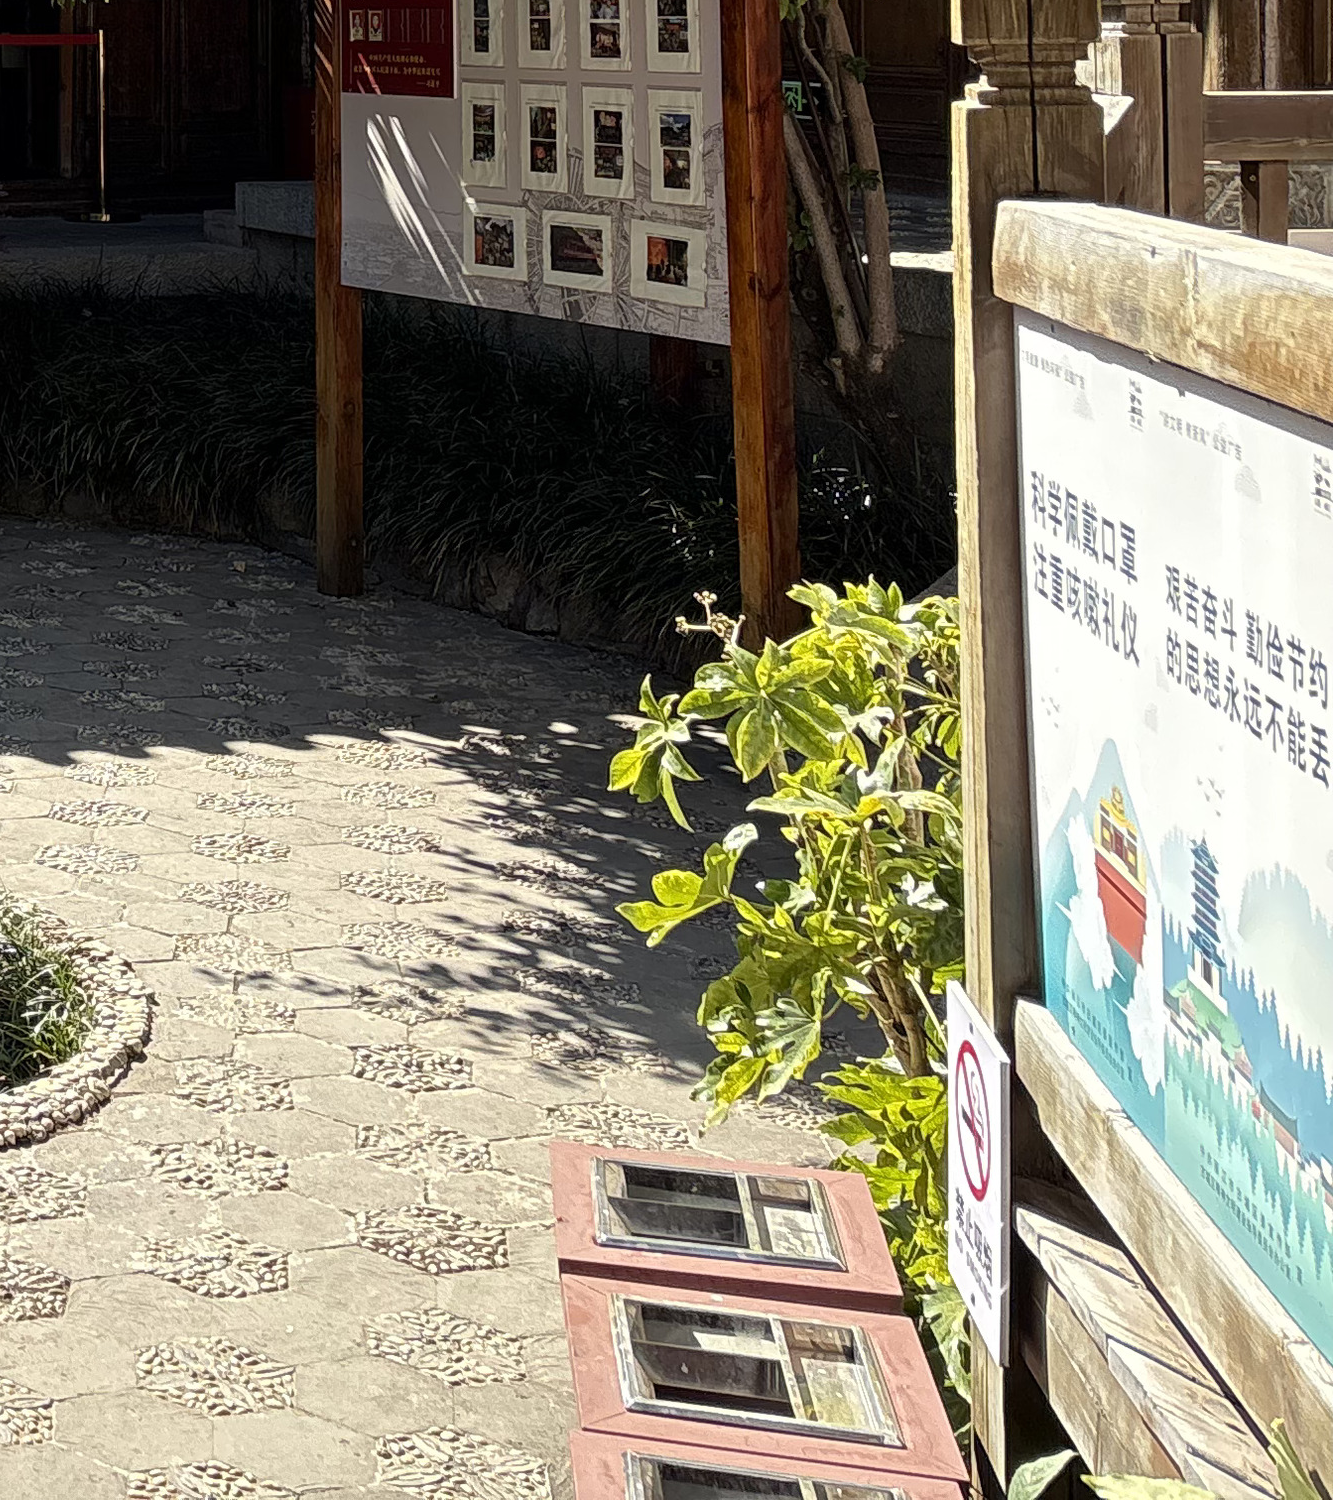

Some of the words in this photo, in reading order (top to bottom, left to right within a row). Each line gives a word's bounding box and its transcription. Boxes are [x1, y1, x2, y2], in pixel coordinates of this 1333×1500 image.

[1030, 469, 1139, 586] 科学佩戴口罩
[1033, 541, 1141, 669] 注重咳嗽礼仪
[1165, 564, 1238, 653] 艰苦奋斗
[1245, 609, 1329, 711] 勤俭节约
[1165, 627, 1332, 789] 的思想永远不能丢
